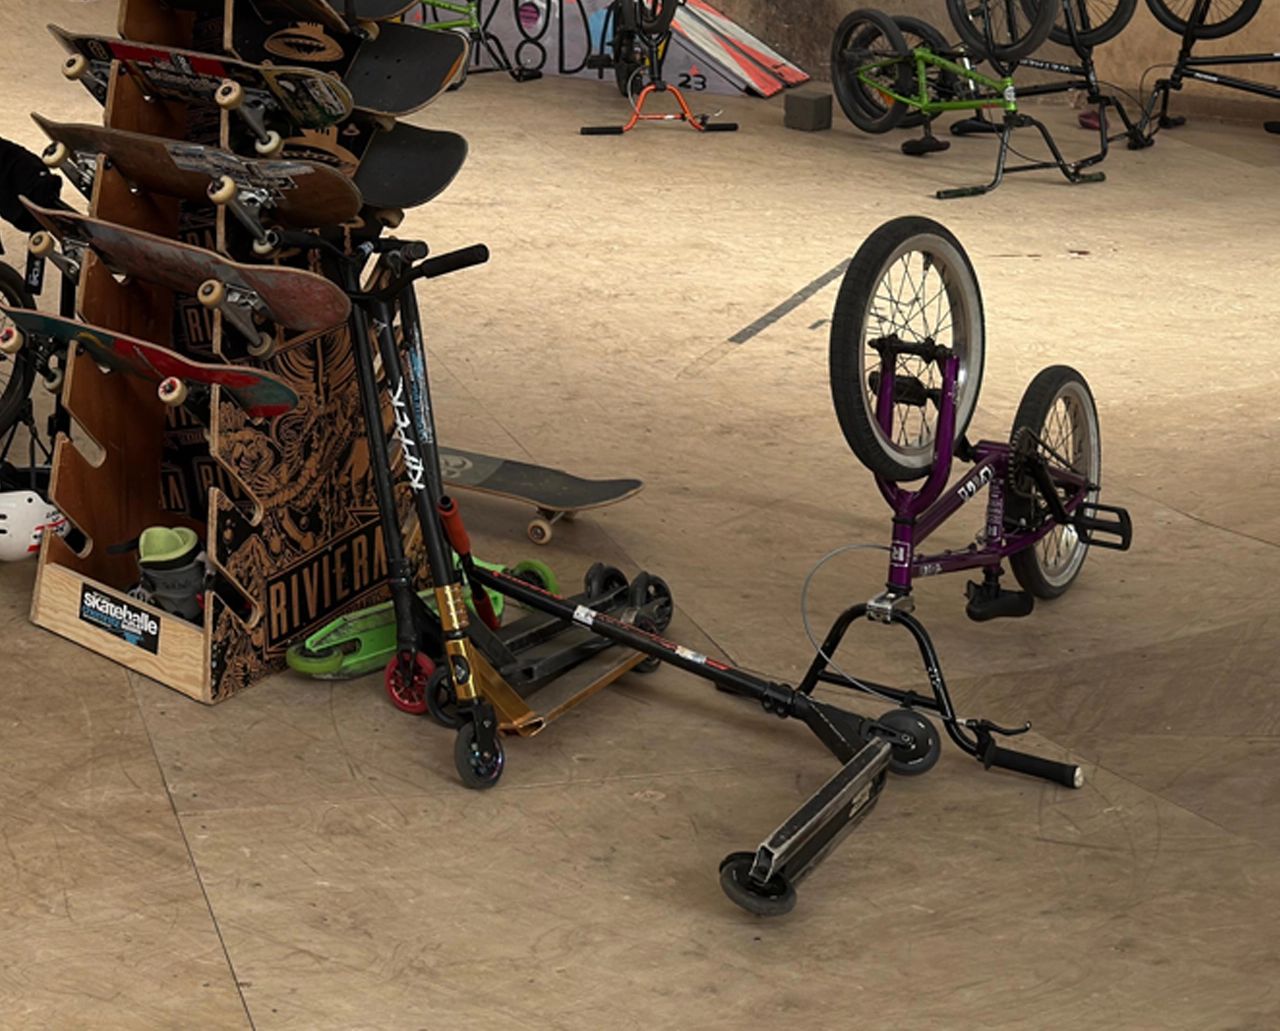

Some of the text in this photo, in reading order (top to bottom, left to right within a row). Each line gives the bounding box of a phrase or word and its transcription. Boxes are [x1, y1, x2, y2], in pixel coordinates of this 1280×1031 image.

[678, 73, 707, 91] 23
[270, 525, 389, 640] RIVIERA
[83, 592, 158, 636] skatehalle
